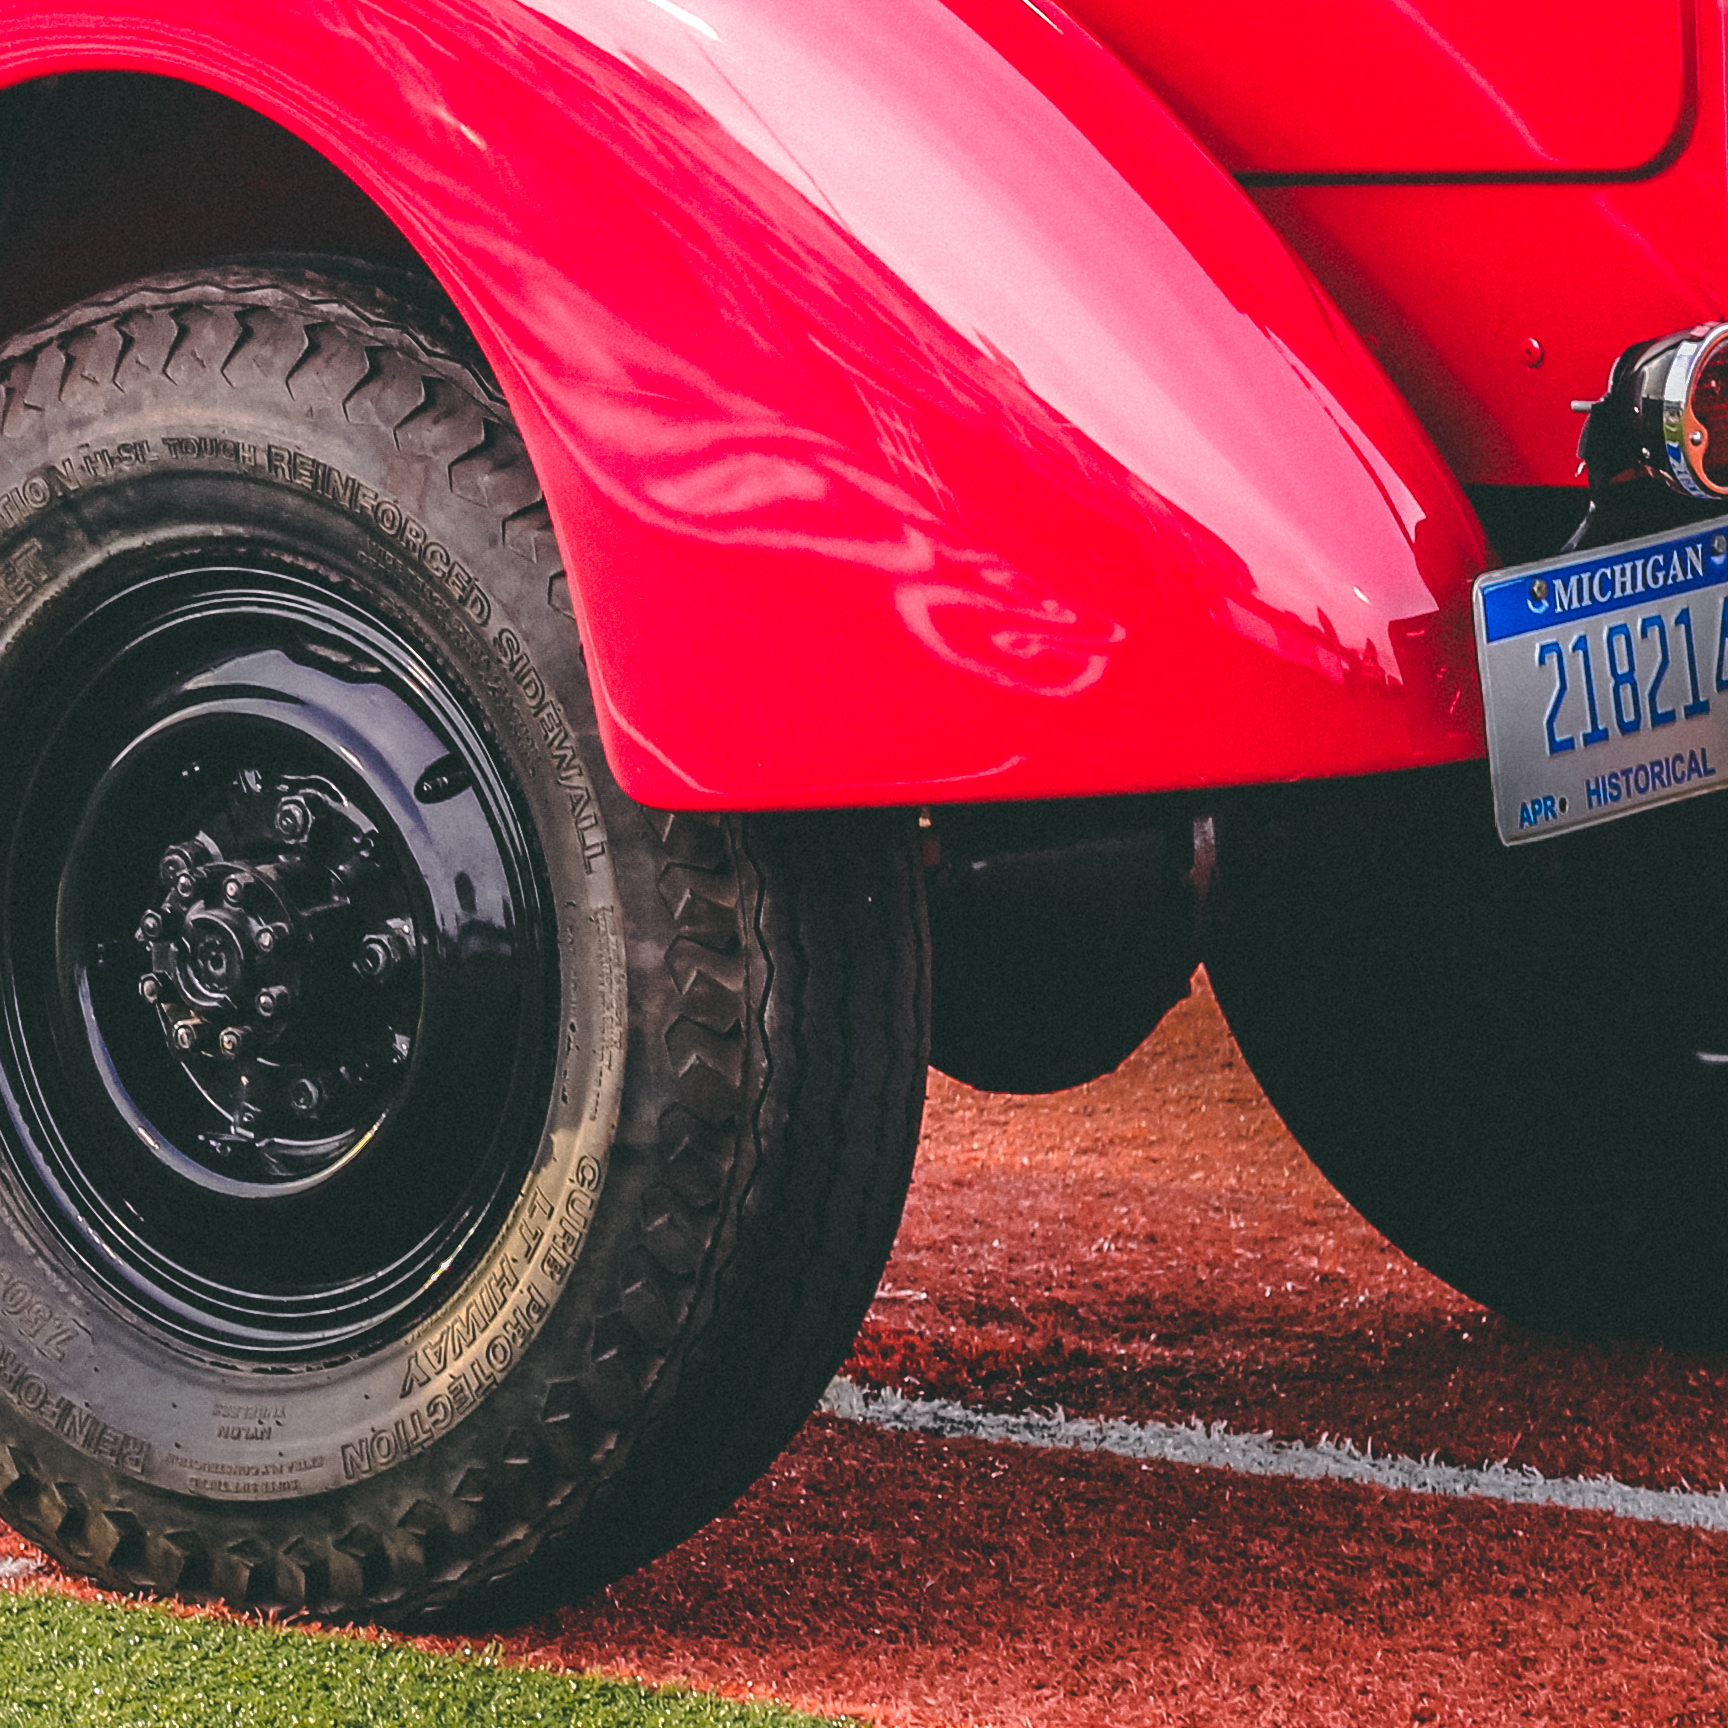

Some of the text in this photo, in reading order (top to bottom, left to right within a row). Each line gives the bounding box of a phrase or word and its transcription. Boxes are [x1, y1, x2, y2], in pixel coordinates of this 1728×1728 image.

[1552, 543, 1705, 614] MICHIGAN
[163, 437, 257, 467] TOUGH
[267, 444, 492, 626] REINFORCED
[494, 628, 607, 875] SIDEWALL
[1519, 747, 1717, 829] APR HISTORICAL
[340, 1154, 601, 1480] CURB PROTECTION
[399, 1186, 556, 1399] LT HIWAY
[217, 1425, 273, 1441] NYLON
